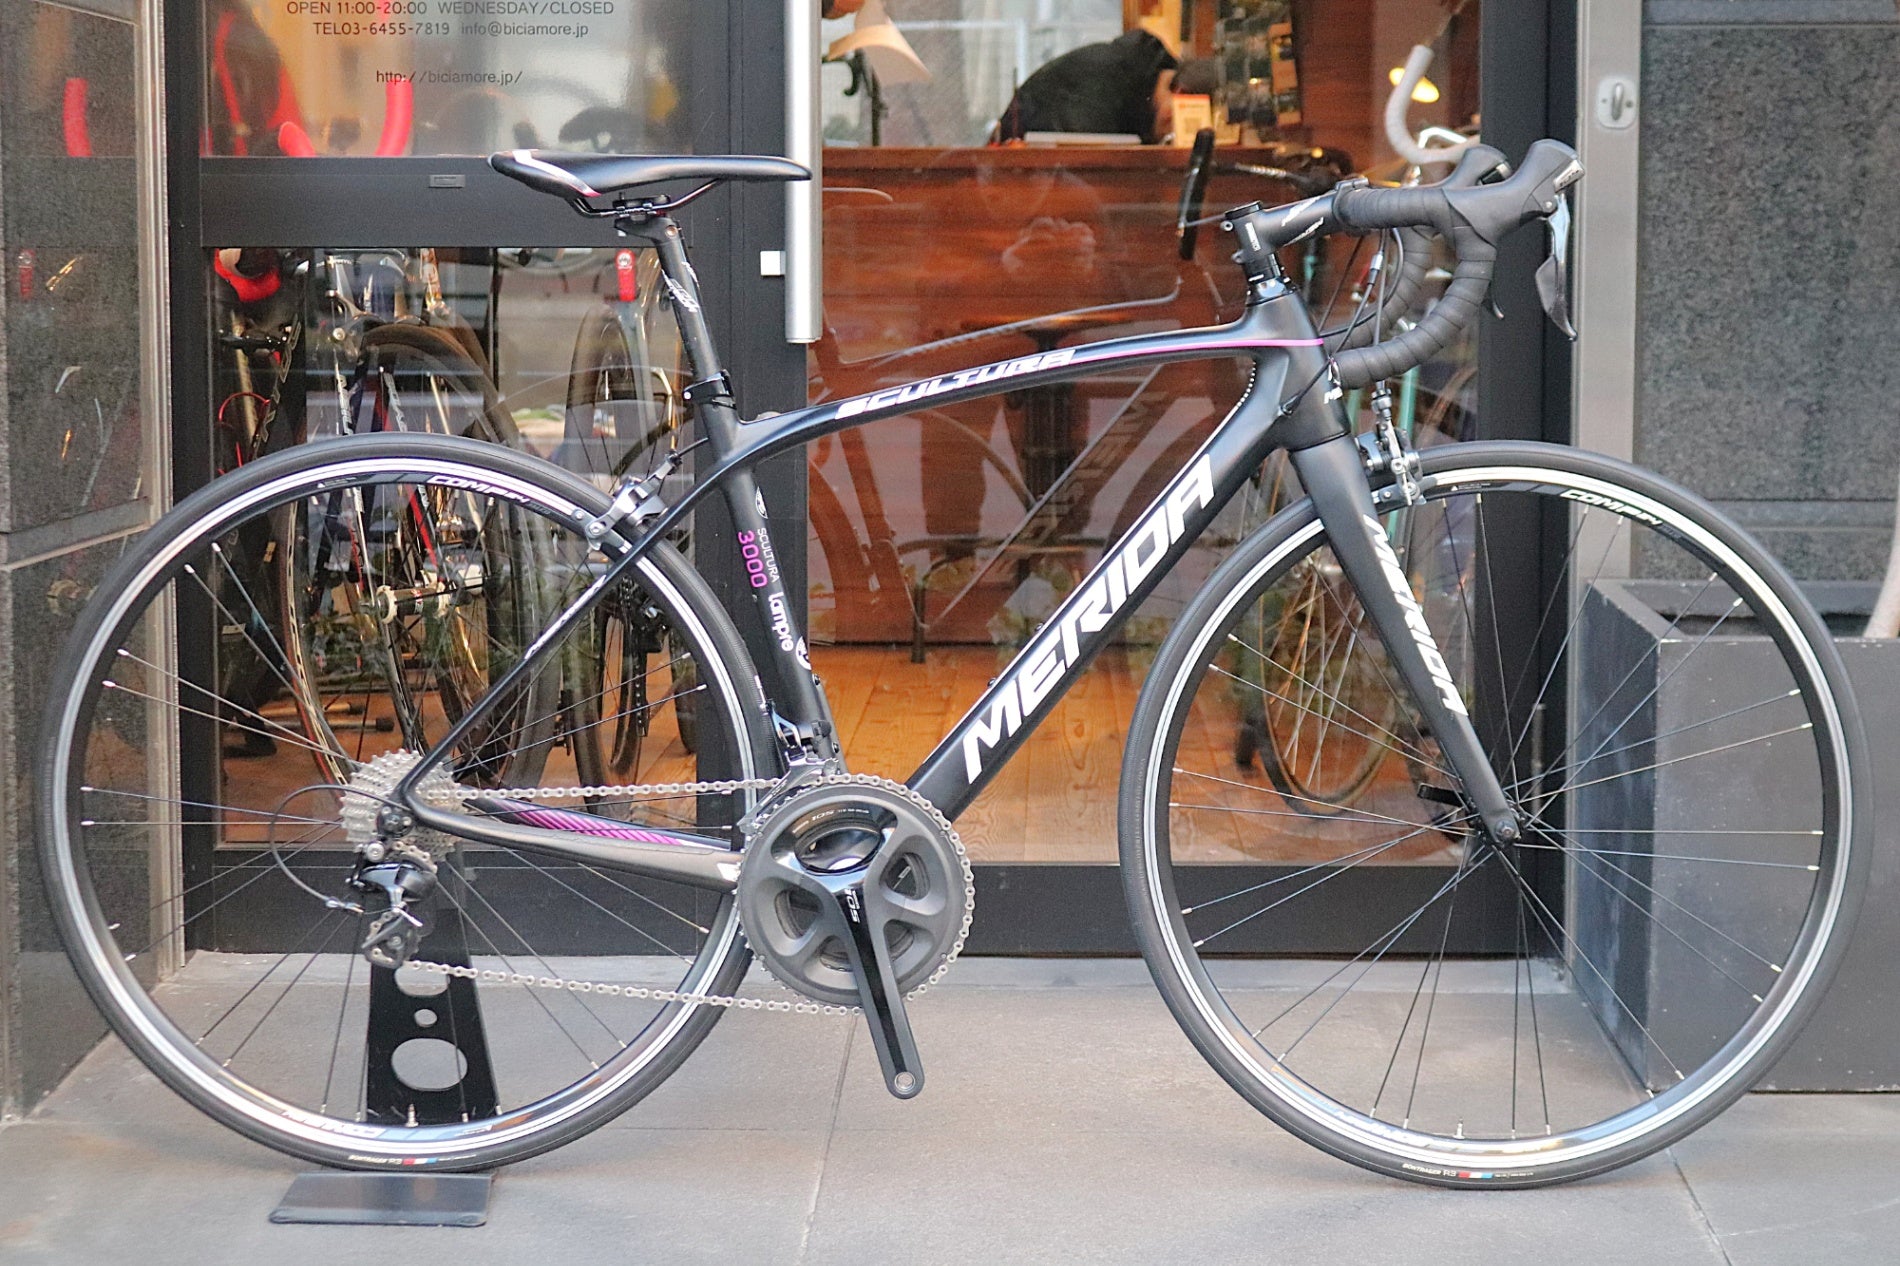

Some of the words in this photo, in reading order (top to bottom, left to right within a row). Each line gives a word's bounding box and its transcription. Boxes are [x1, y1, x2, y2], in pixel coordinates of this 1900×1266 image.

[286, 1, 331, 15] OPEN
[337, 1, 428, 15] 11:00-20:00
[438, 1, 615, 15] WEDNESDAY/CLOSED
[313, 22, 451, 36] TEL03-6455-7819
[461, 22, 589, 37] info@biciamore.jp
[375, 70, 523, 84] http://biciamore.jp/
[834, 349, 1076, 419] SCULTURA
[738, 530, 768, 588] 3000
[757, 527, 780, 583] SCULTURA
[768, 591, 795, 652] lampre
[962, 453, 1215, 785] MERIDA
[1363, 514, 1470, 717] MERIDA
